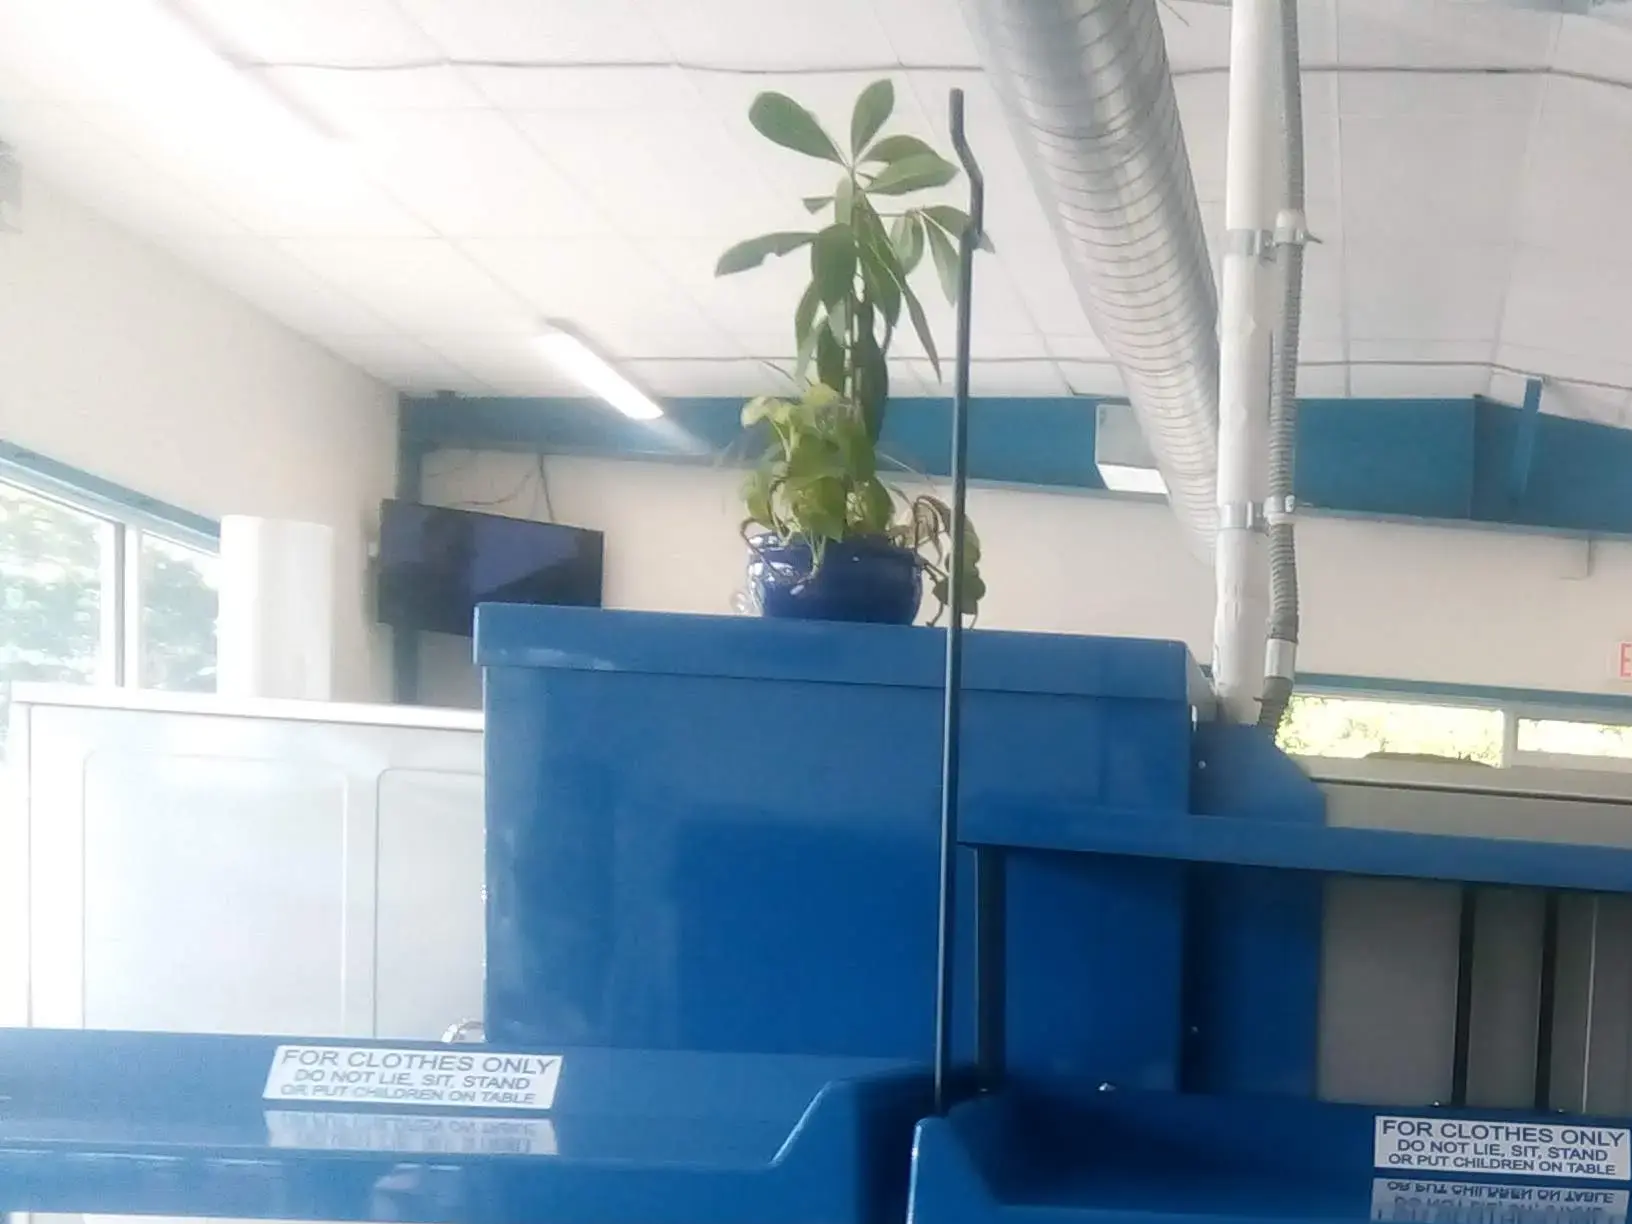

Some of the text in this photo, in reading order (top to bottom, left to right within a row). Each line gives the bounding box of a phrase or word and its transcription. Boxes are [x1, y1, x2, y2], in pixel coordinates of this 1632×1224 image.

[281, 1049, 556, 1074] FOR CLOTHES ONLY
[294, 1068, 326, 1082] DO
[330, 1070, 376, 1084] NOT
[463, 1075, 531, 1090] STAND
[280, 1084, 537, 1104] OR PUT CHILDREN ON TABLE
[1382, 1119, 1625, 1147] FOR CLOTHES ONLY
[1397, 1139, 1425, 1152] DO
[1430, 1141, 1470, 1154] NOT
[1547, 1146, 1609, 1161] STAND
[1388, 1153, 1616, 1176] OR PUT CHILDREN ON TABLE
